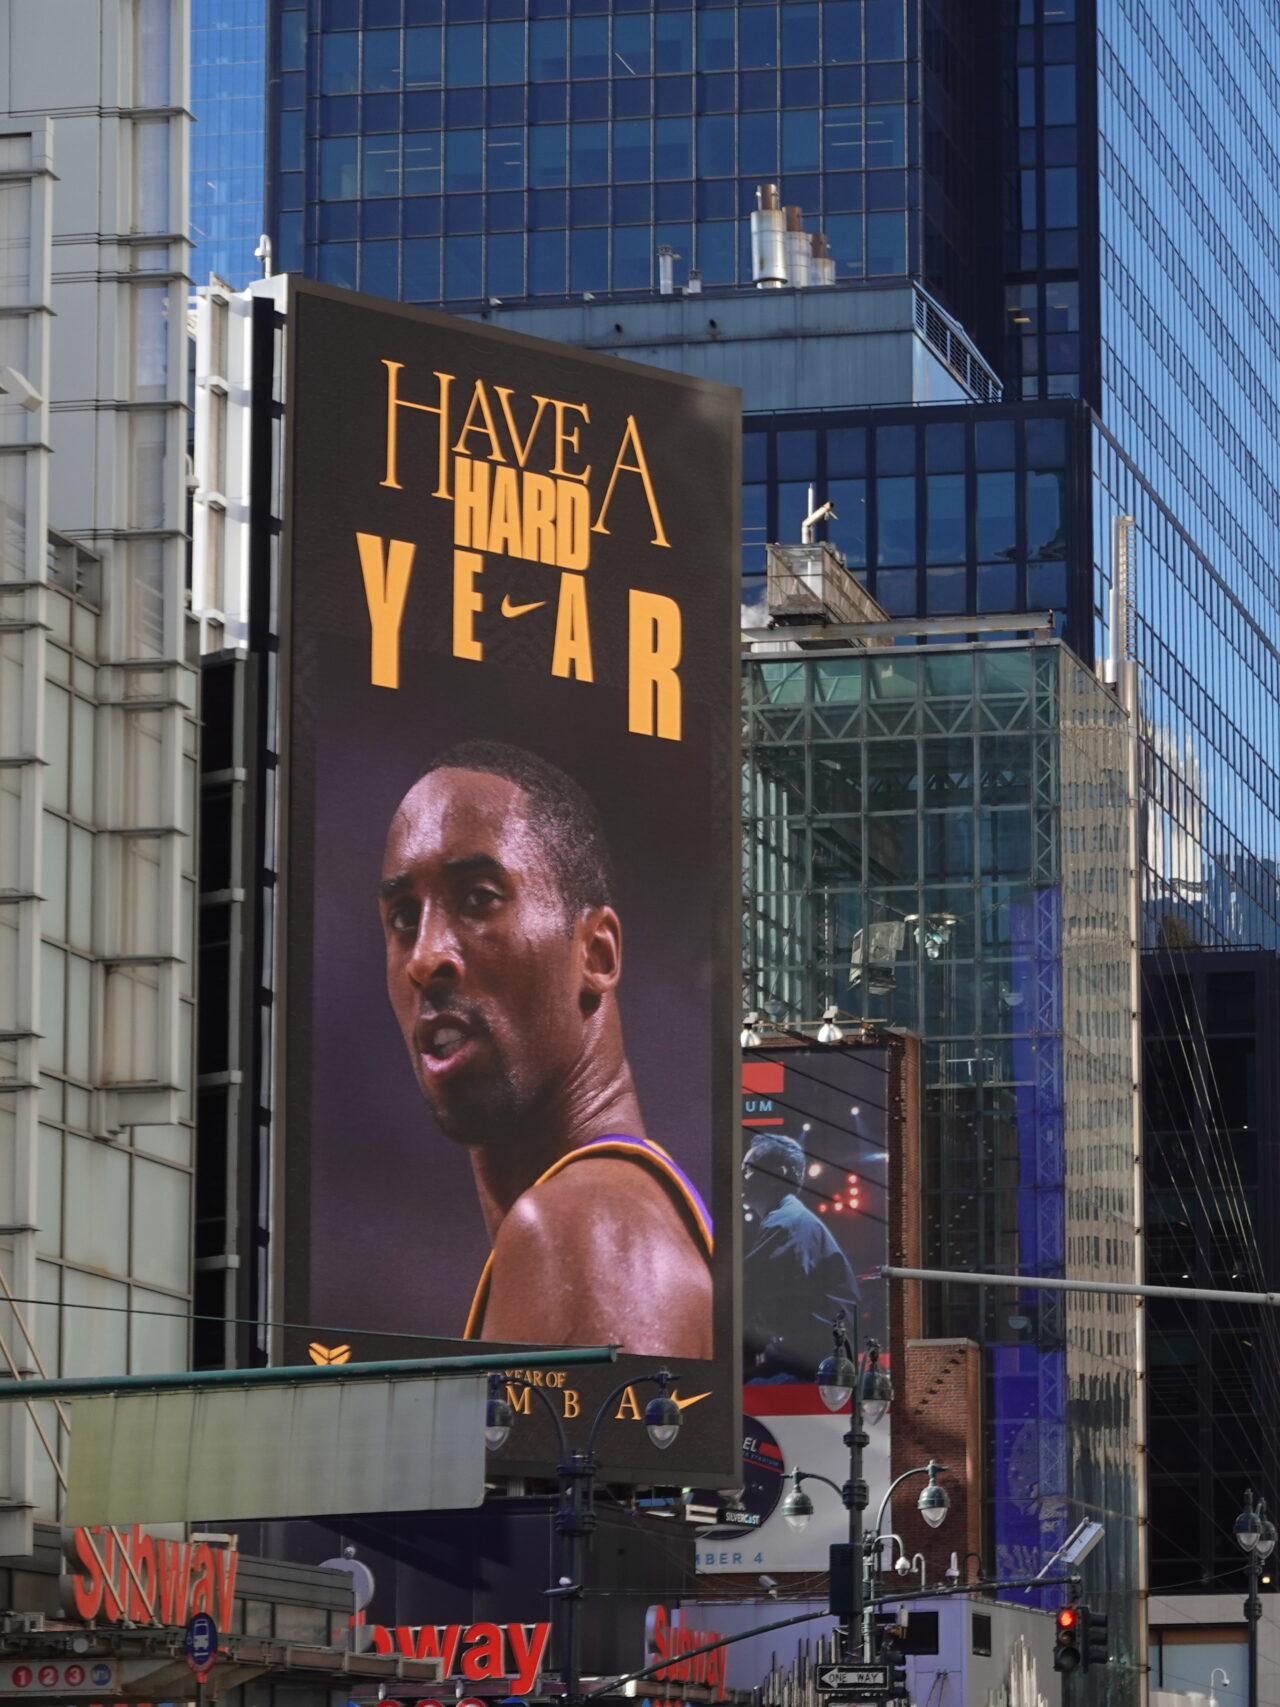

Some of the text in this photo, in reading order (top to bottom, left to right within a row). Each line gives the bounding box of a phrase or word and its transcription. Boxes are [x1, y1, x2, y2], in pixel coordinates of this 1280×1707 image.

[379, 358, 672, 548] HAVE A
[453, 455, 592, 571] HARD
[545, 1371, 567, 1388] OF
[754, 1552, 763, 1564] 4
[73, 1523, 239, 1645] Subway
[17, 1669, 27, 1685] 1
[41, 1667, 56, 1684] 2
[69, 1667, 81, 1685] 3
[828, 1673, 878, 1683] ONE WAY
